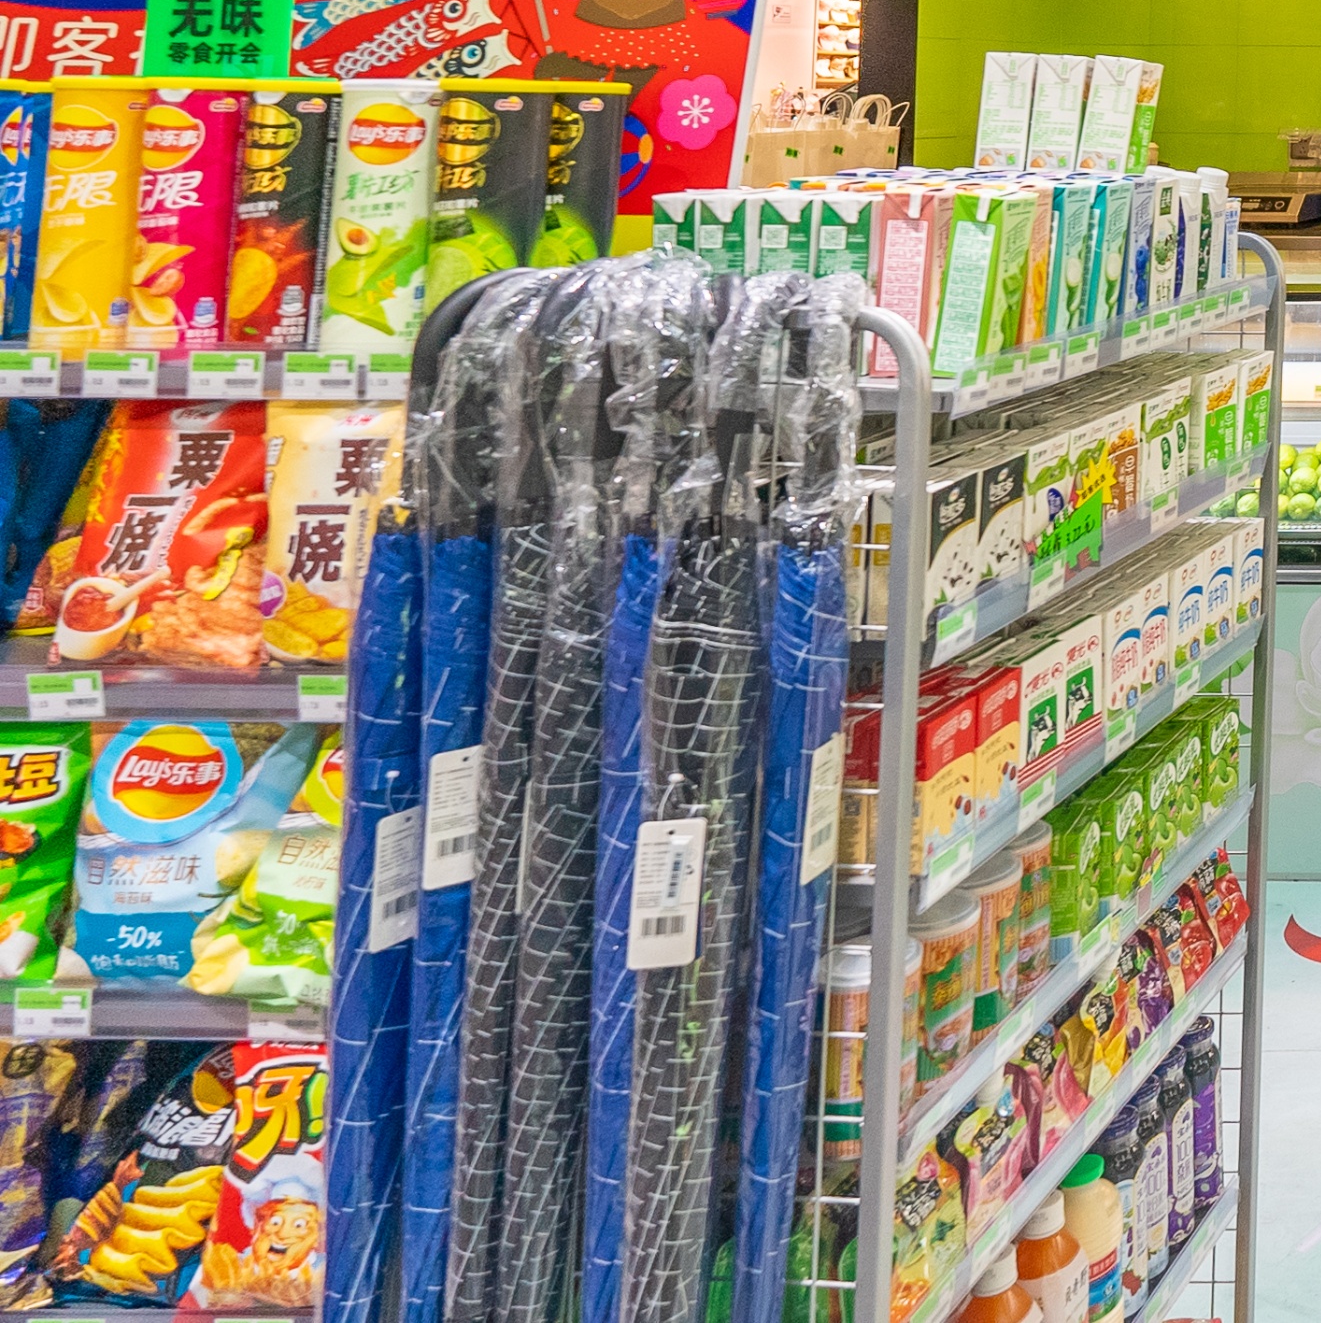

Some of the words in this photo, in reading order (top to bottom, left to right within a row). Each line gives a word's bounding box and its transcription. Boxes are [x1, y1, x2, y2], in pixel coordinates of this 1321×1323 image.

[0, 15, 146, 77] 即客
[168, 41, 262, 65] 零食开会
[116, 754, 224, 787] Lay's乐事
[87, 854, 203, 886] 自然滋味
